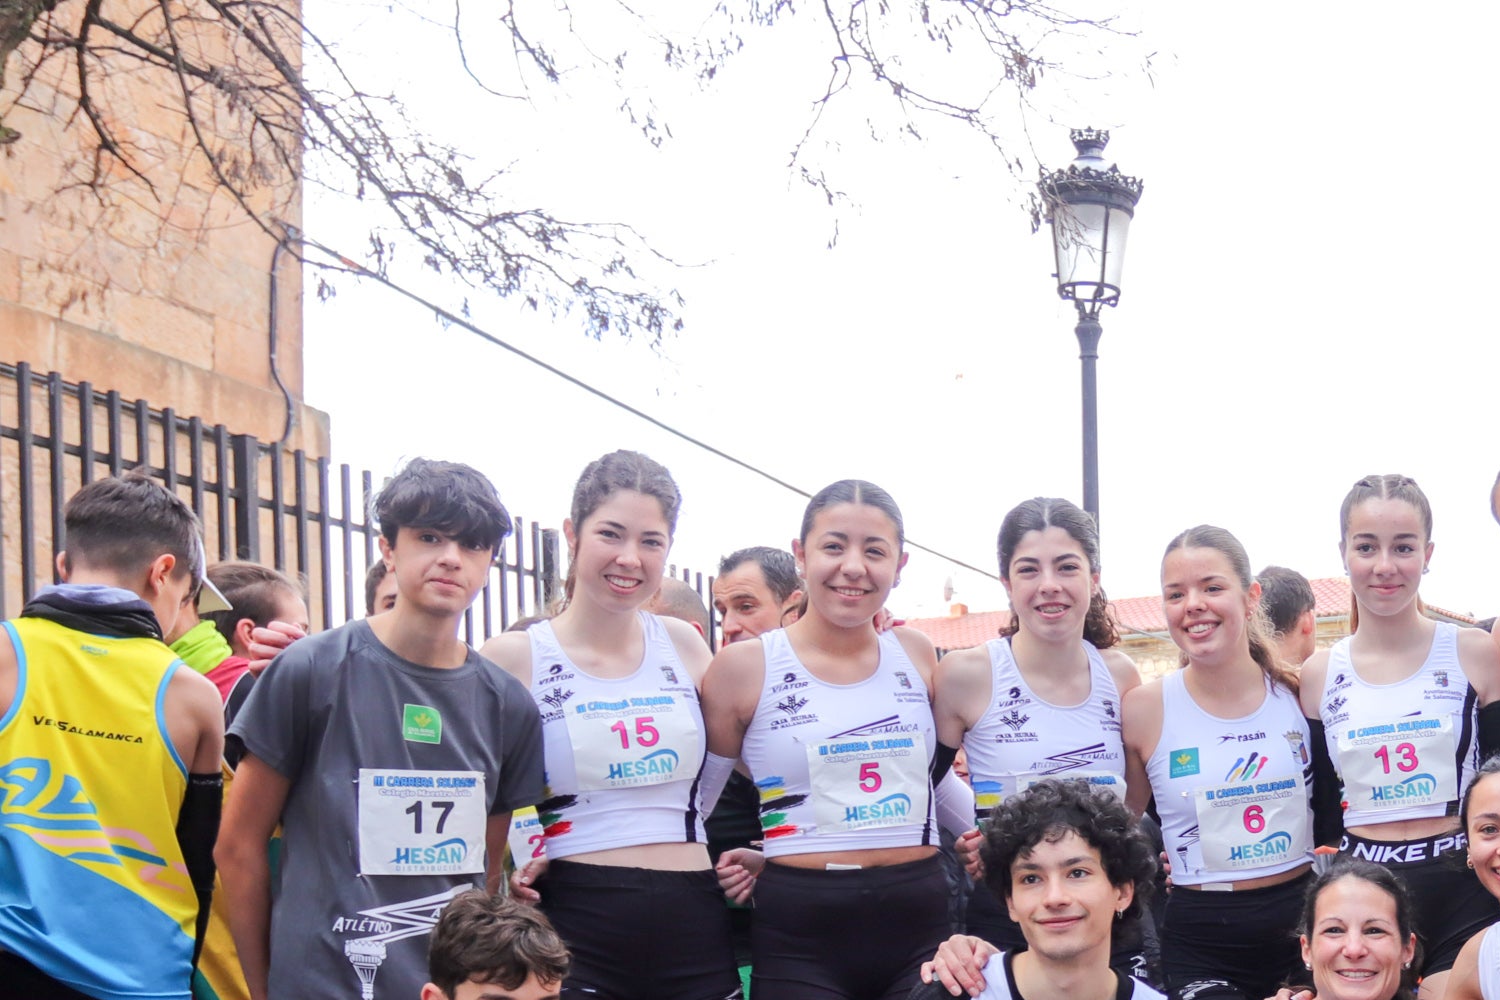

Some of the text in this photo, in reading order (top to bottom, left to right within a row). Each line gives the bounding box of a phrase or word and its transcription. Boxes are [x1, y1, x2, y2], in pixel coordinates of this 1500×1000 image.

[771, 681, 808, 695] VIATOR
[611, 717, 660, 749] 15
[1237, 731, 1266, 743] rasán
[830, 741, 870, 754] CARRERA
[606, 758, 673, 779] HESAN
[1374, 743, 1419, 774] 13
[374, 776, 434, 788] III CARRERA
[859, 762, 882, 793] 5
[379, 788, 416, 798] Colegio
[1216, 785, 1254, 799] CARRERA
[1371, 781, 1430, 801] HESAN
[405, 800, 455, 834] 17
[844, 801, 906, 822] HESAN
[1243, 805, 1265, 834] 6
[391, 847, 462, 864] HESAN
[1228, 838, 1286, 861] HESAN
[1352, 842, 1427, 863] NIKE
[1433, 832, 1467, 857] PR
[332, 917, 392, 934] ATLÉTICO
